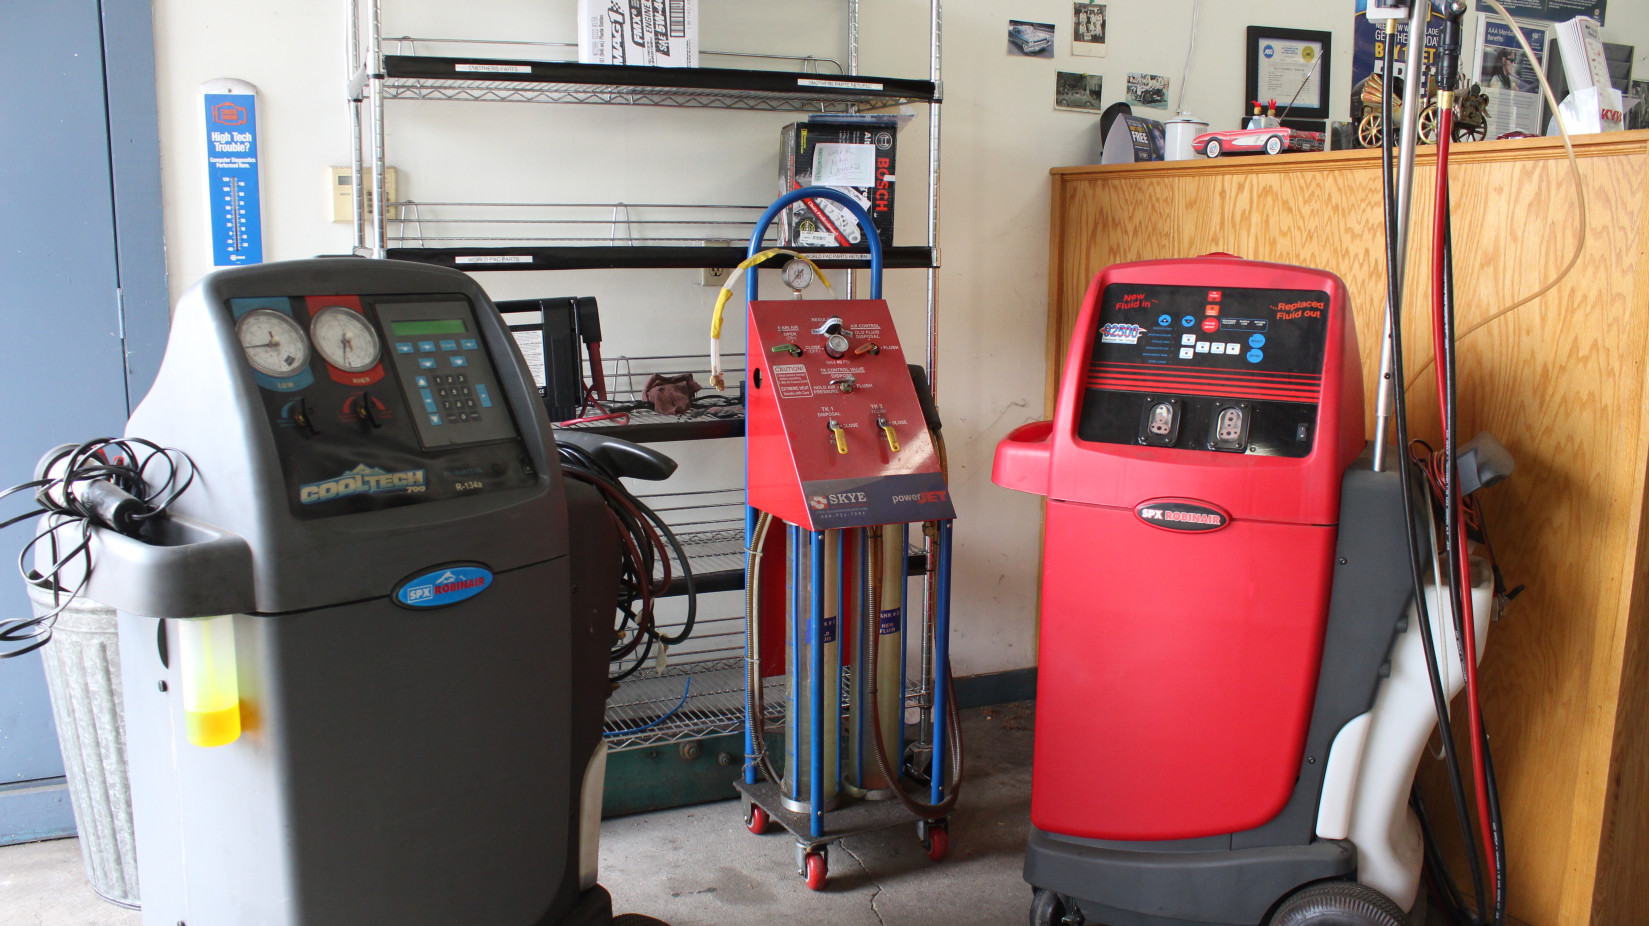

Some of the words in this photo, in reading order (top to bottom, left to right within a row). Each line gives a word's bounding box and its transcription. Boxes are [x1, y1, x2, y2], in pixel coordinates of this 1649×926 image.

[644, 3, 652, 34] ENGINE
[608, 8, 625, 65] MAG1
[1375, 30, 1385, 40] GE
[658, 34, 669, 51] SAE
[1375, 42, 1401, 59] BY
[1424, 48, 1436, 63] ET
[1602, 108, 1622, 122] KYB
[211, 132, 231, 143] High
[232, 132, 252, 142] Tech
[1131, 131, 1149, 143] FREE
[214, 142, 250, 152] Trouble?
[876, 158, 890, 211] BOSCH
[1116, 301, 1140, 310] Fluid
[1277, 310, 1302, 319] Fluid
[301, 473, 424, 502] COOLTECH
[456, 481, 483, 490] R-134a
[829, 492, 866, 504] SKYE
[1142, 509, 1163, 520] SPX
[1165, 511, 1221, 525] ROBINAIR
[409, 586, 431, 600] SPX
[434, 577, 484, 595] ROBINAIR
